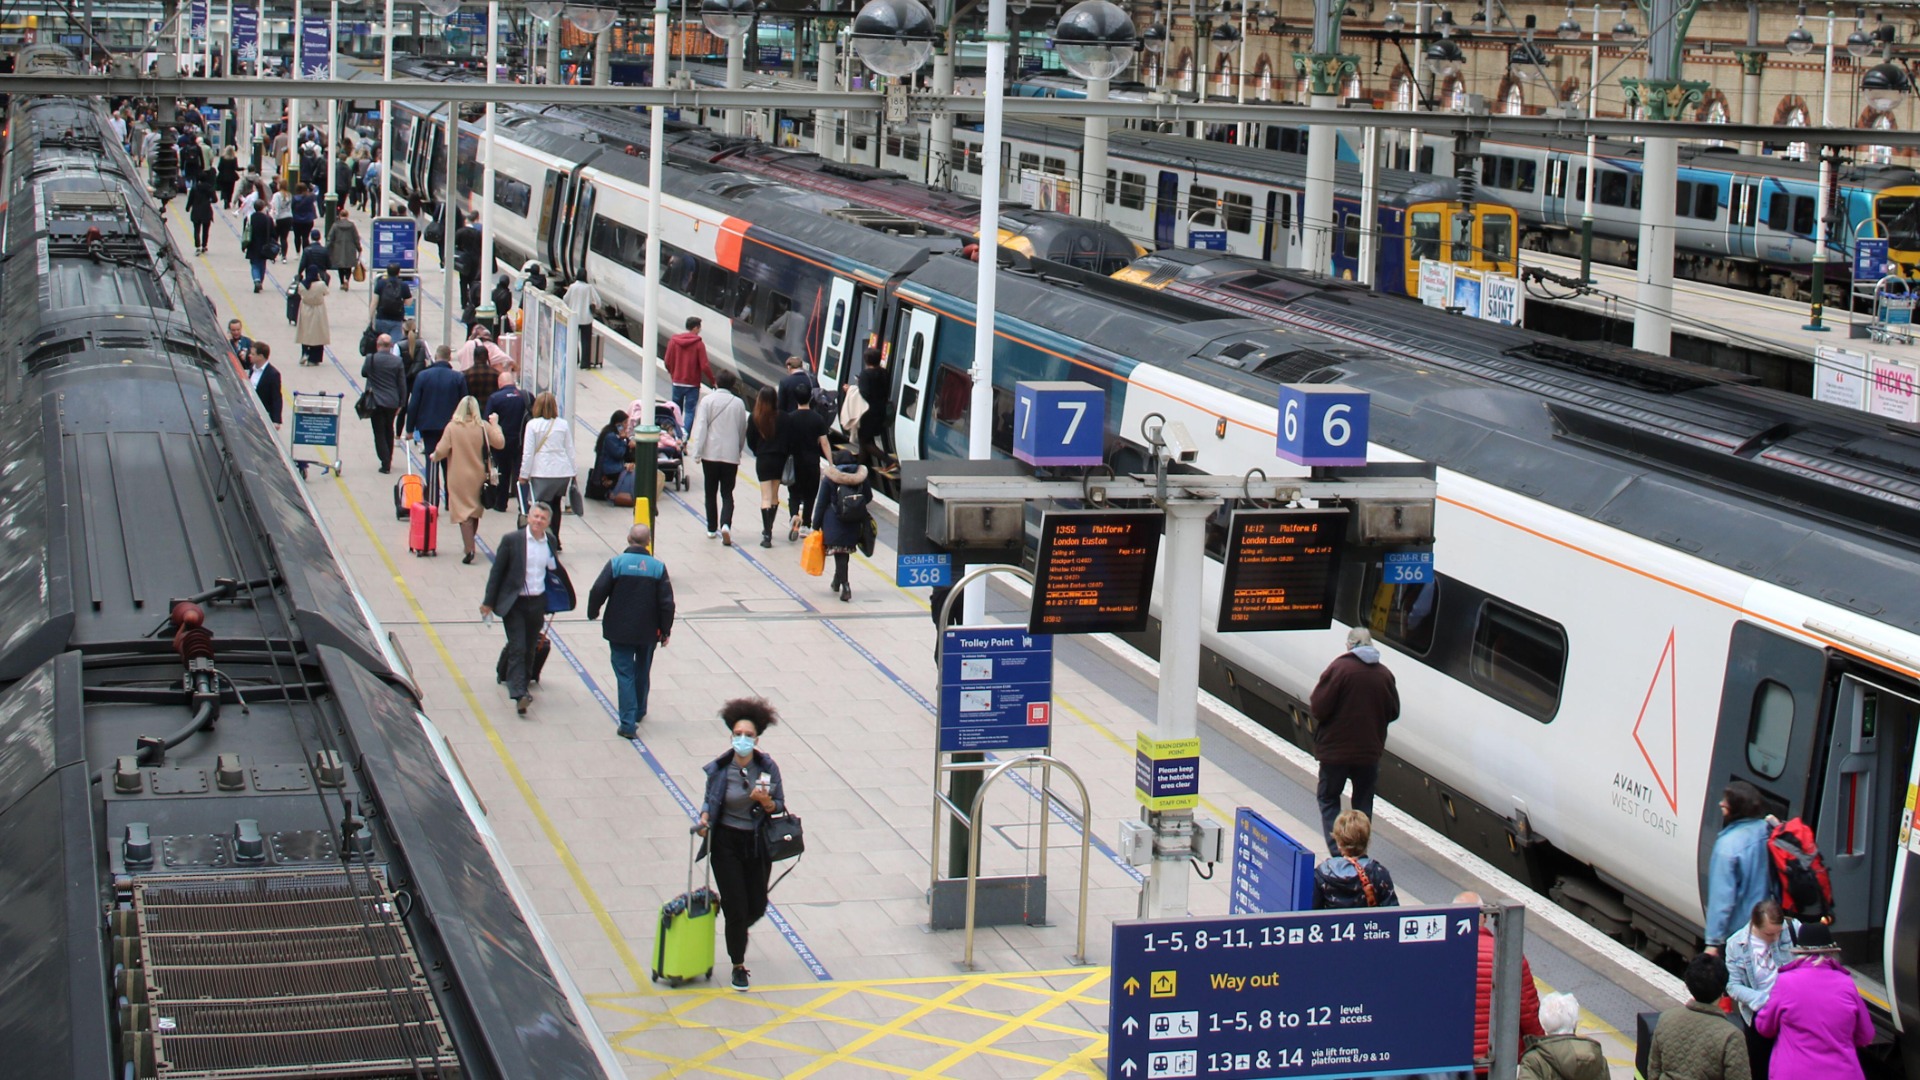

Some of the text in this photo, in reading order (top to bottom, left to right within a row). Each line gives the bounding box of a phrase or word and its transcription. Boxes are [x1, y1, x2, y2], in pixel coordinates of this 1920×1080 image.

[1488, 282, 1515, 302] LUCKY
[1488, 300, 1514, 320] SAINT
[1021, 396, 1031, 439] 7
[1058, 402, 1086, 444] 7
[1285, 399, 1298, 441] 6
[1322, 404, 1351, 446] 6
[1092, 525, 1123, 533] Platform
[1280, 524, 1310, 532] Platform
[1053, 537, 1107, 546] London Euston
[1242, 536, 1294, 544] London Euston
[904, 555, 934, 564] GSM-R
[1390, 554, 1418, 562] GSM-R
[909, 568, 940, 583] 368
[1394, 566, 1423, 580] 366
[960, 638, 1014, 648] Trolley Point
[1169, 773, 1194, 781] hatched
[1613, 772, 1652, 804] AVANTI
[1611, 791, 1678, 838] WEST COAST
[1251, 855, 1263, 869] Buses
[1250, 869, 1259, 884] Taxis
[780, 924, 792, 933] Stay
[1364, 921, 1378, 930] via
[1260, 926, 1285, 946] 13
[1308, 924, 1323, 943] &
[1330, 922, 1356, 942] 14
[1363, 930, 1390, 940] stairs
[795, 944, 808, 953] help
[811, 964, 825, 975] Help
[1210, 972, 1279, 992] Way out
[1340, 1004, 1363, 1014] level
[1259, 1010, 1271, 1029] 8
[1278, 1011, 1299, 1027] to
[1306, 1006, 1331, 1026] 12
[1340, 1014, 1372, 1024] access
[1312, 1047, 1359, 1057] via lift from
[1207, 1048, 1303, 1072] 13 & 14
[1311, 1054, 1351, 1067] platforms
[1353, 1054, 1369, 1063] 8/9
[1379, 1052, 1390, 1061] 10
